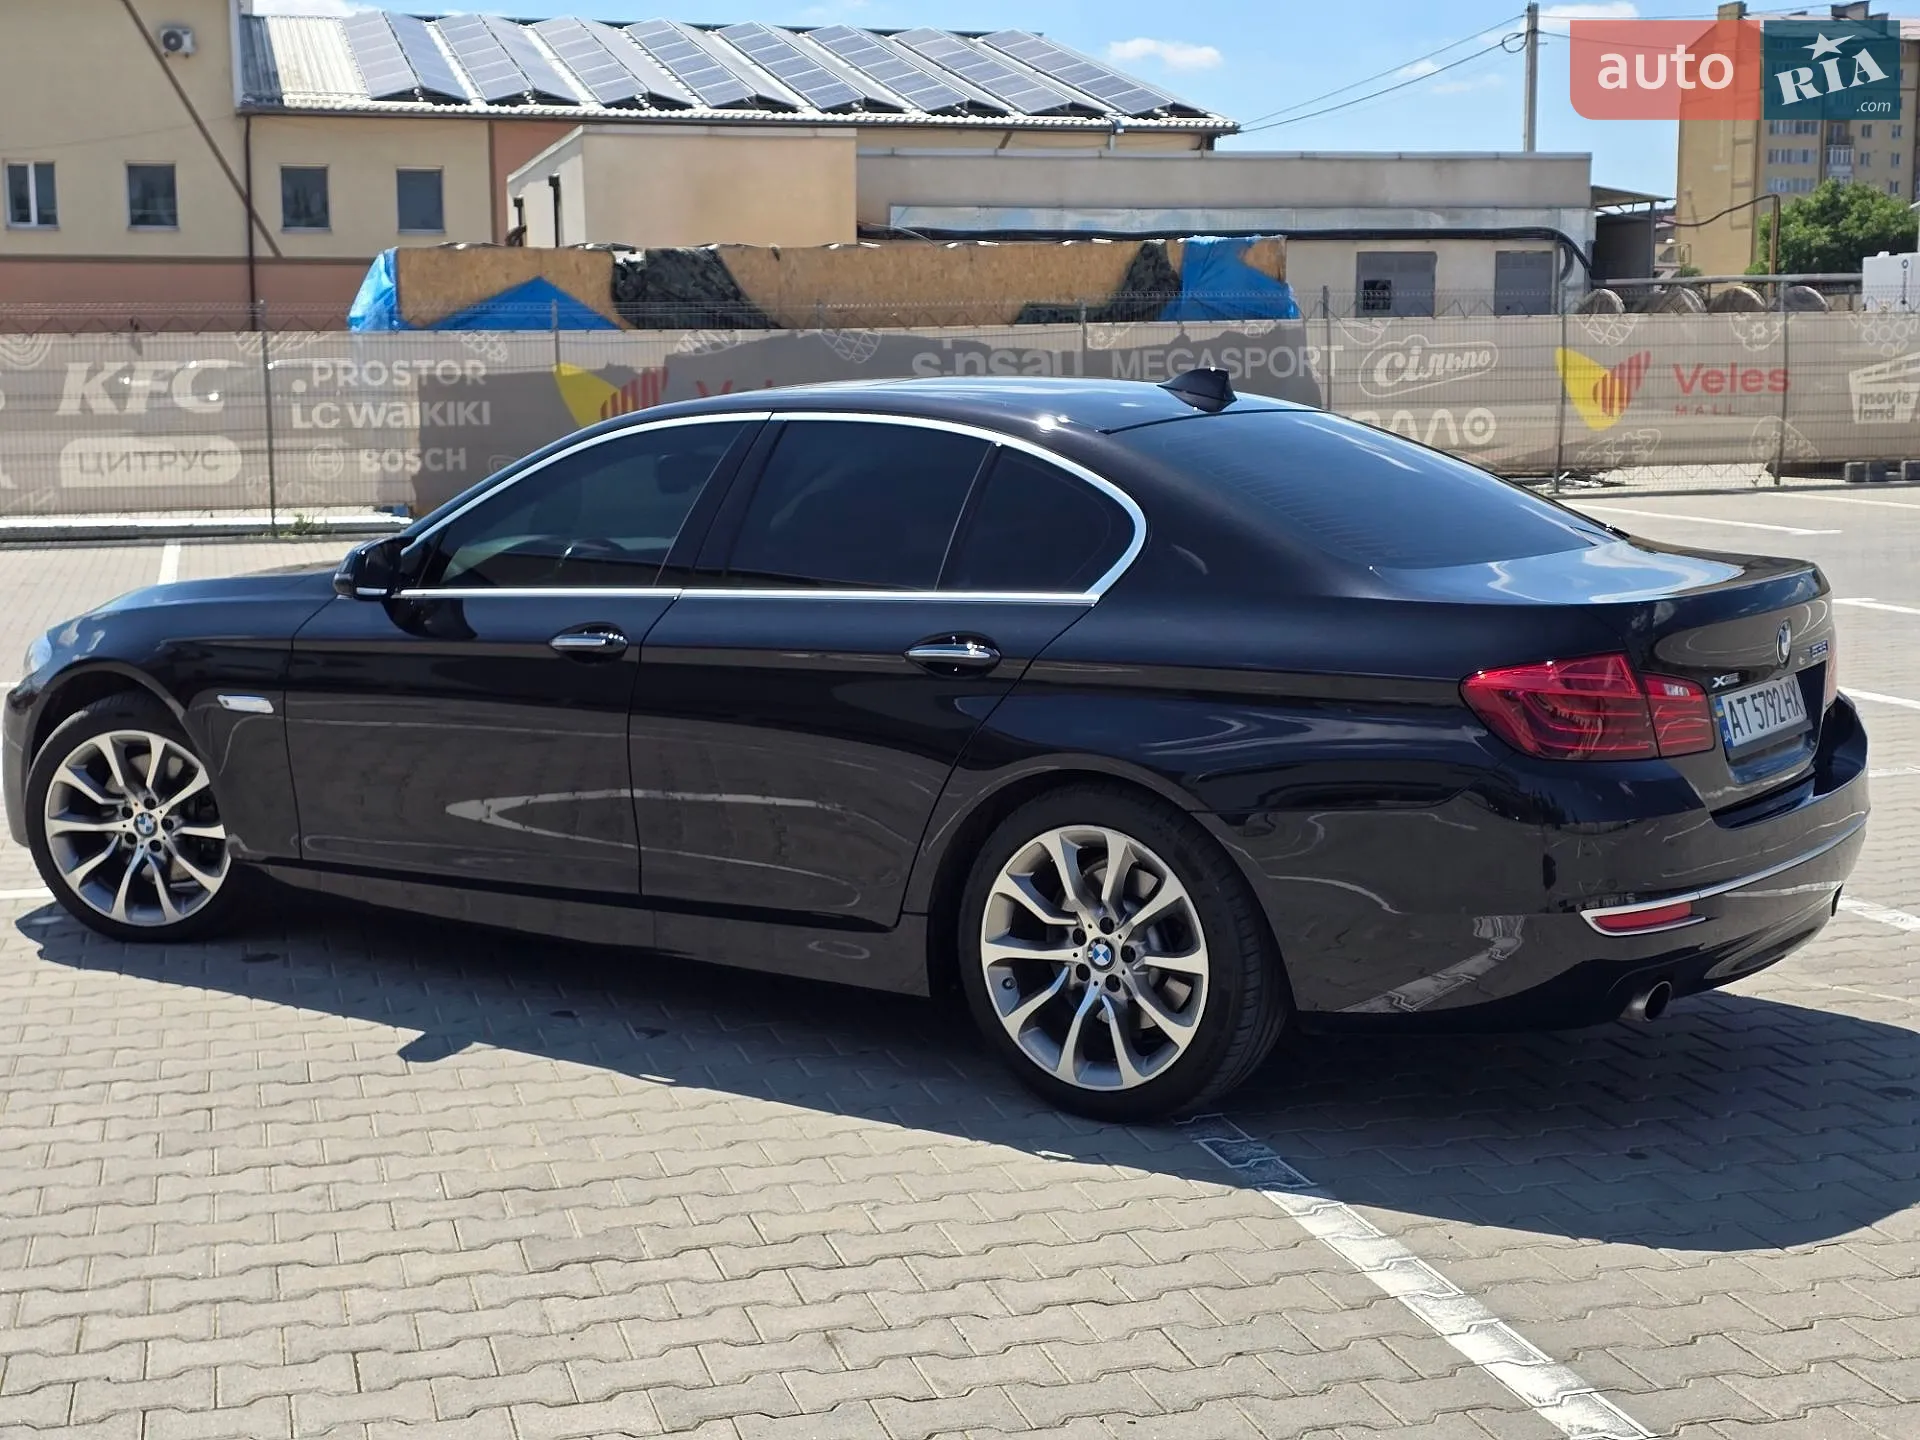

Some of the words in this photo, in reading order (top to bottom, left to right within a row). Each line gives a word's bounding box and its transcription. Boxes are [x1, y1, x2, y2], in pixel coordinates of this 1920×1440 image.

[1112, 345, 1344, 380] MEGASPORT
[1374, 345, 1491, 387] Сільпо
[55, 359, 244, 415] KFC
[1673, 362, 1790, 395] Veles
[1675, 404, 1735, 415] MALL
[1859, 389, 1910, 404] movie
[292, 402, 340, 428] LC
[79, 450, 219, 476] ЦИТРУС
[360, 448, 466, 473] BOSCH
